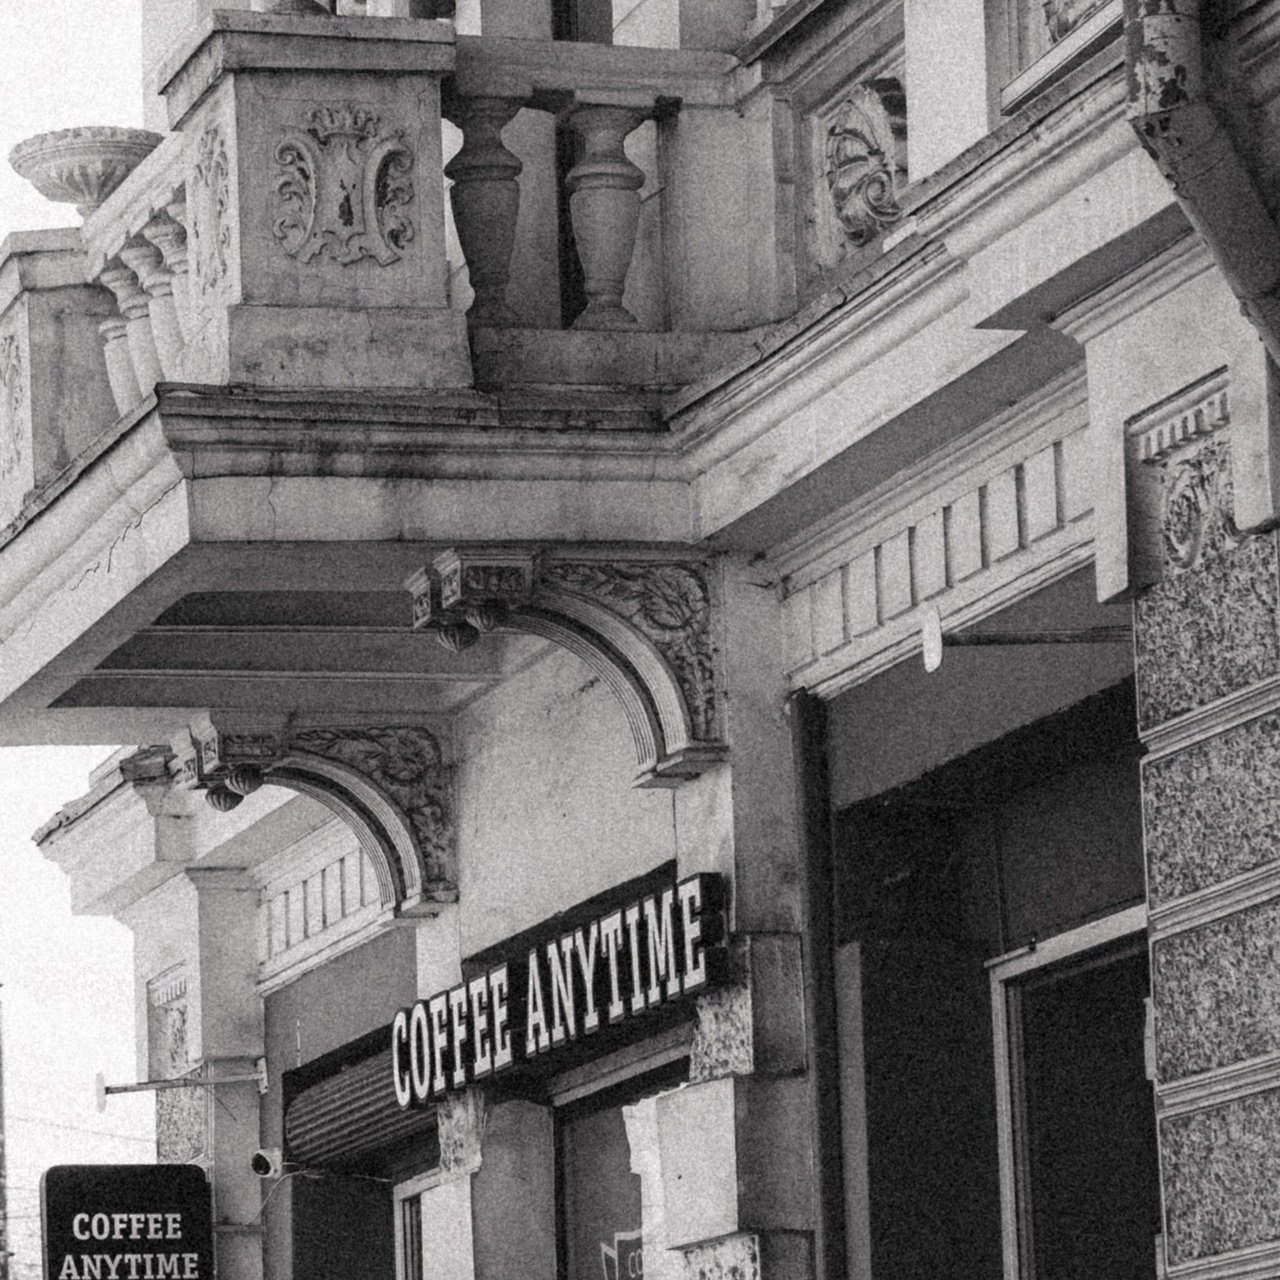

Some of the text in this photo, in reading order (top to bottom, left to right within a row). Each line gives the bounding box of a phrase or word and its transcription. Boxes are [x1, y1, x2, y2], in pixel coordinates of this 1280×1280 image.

[392, 877, 707, 1110] COFFEE ANYTIME
[72, 1212, 183, 1241] COFFEE
[58, 1253, 200, 1280] ANYTIME
